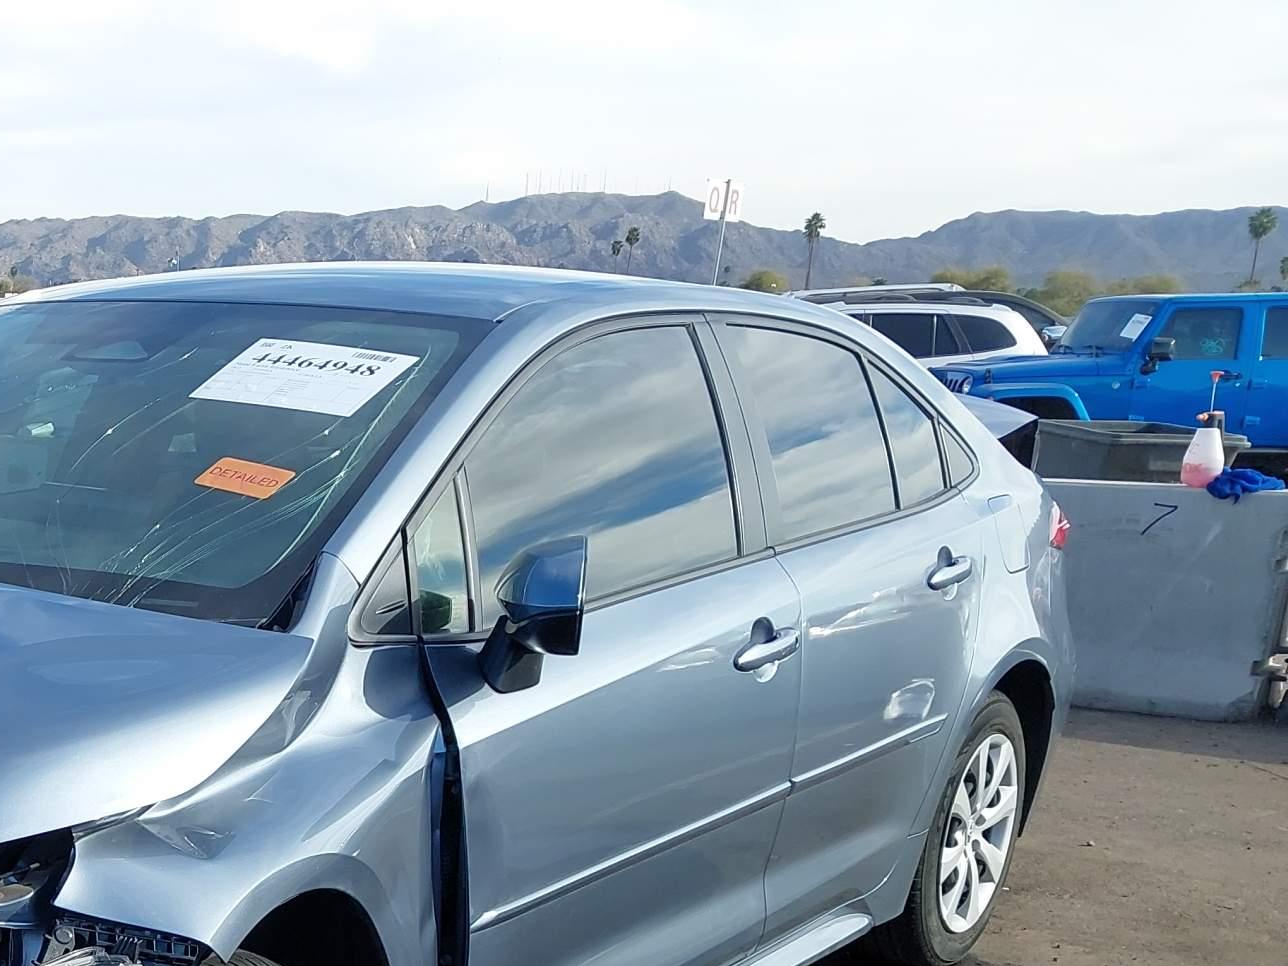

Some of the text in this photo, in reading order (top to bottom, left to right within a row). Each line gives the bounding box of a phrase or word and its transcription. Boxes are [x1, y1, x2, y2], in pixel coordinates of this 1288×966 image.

[728, 188, 740, 215] R
[252, 352, 381, 376] 44464948
[209, 466, 279, 488] DETAILED
[1140, 503, 1178, 536] 7
